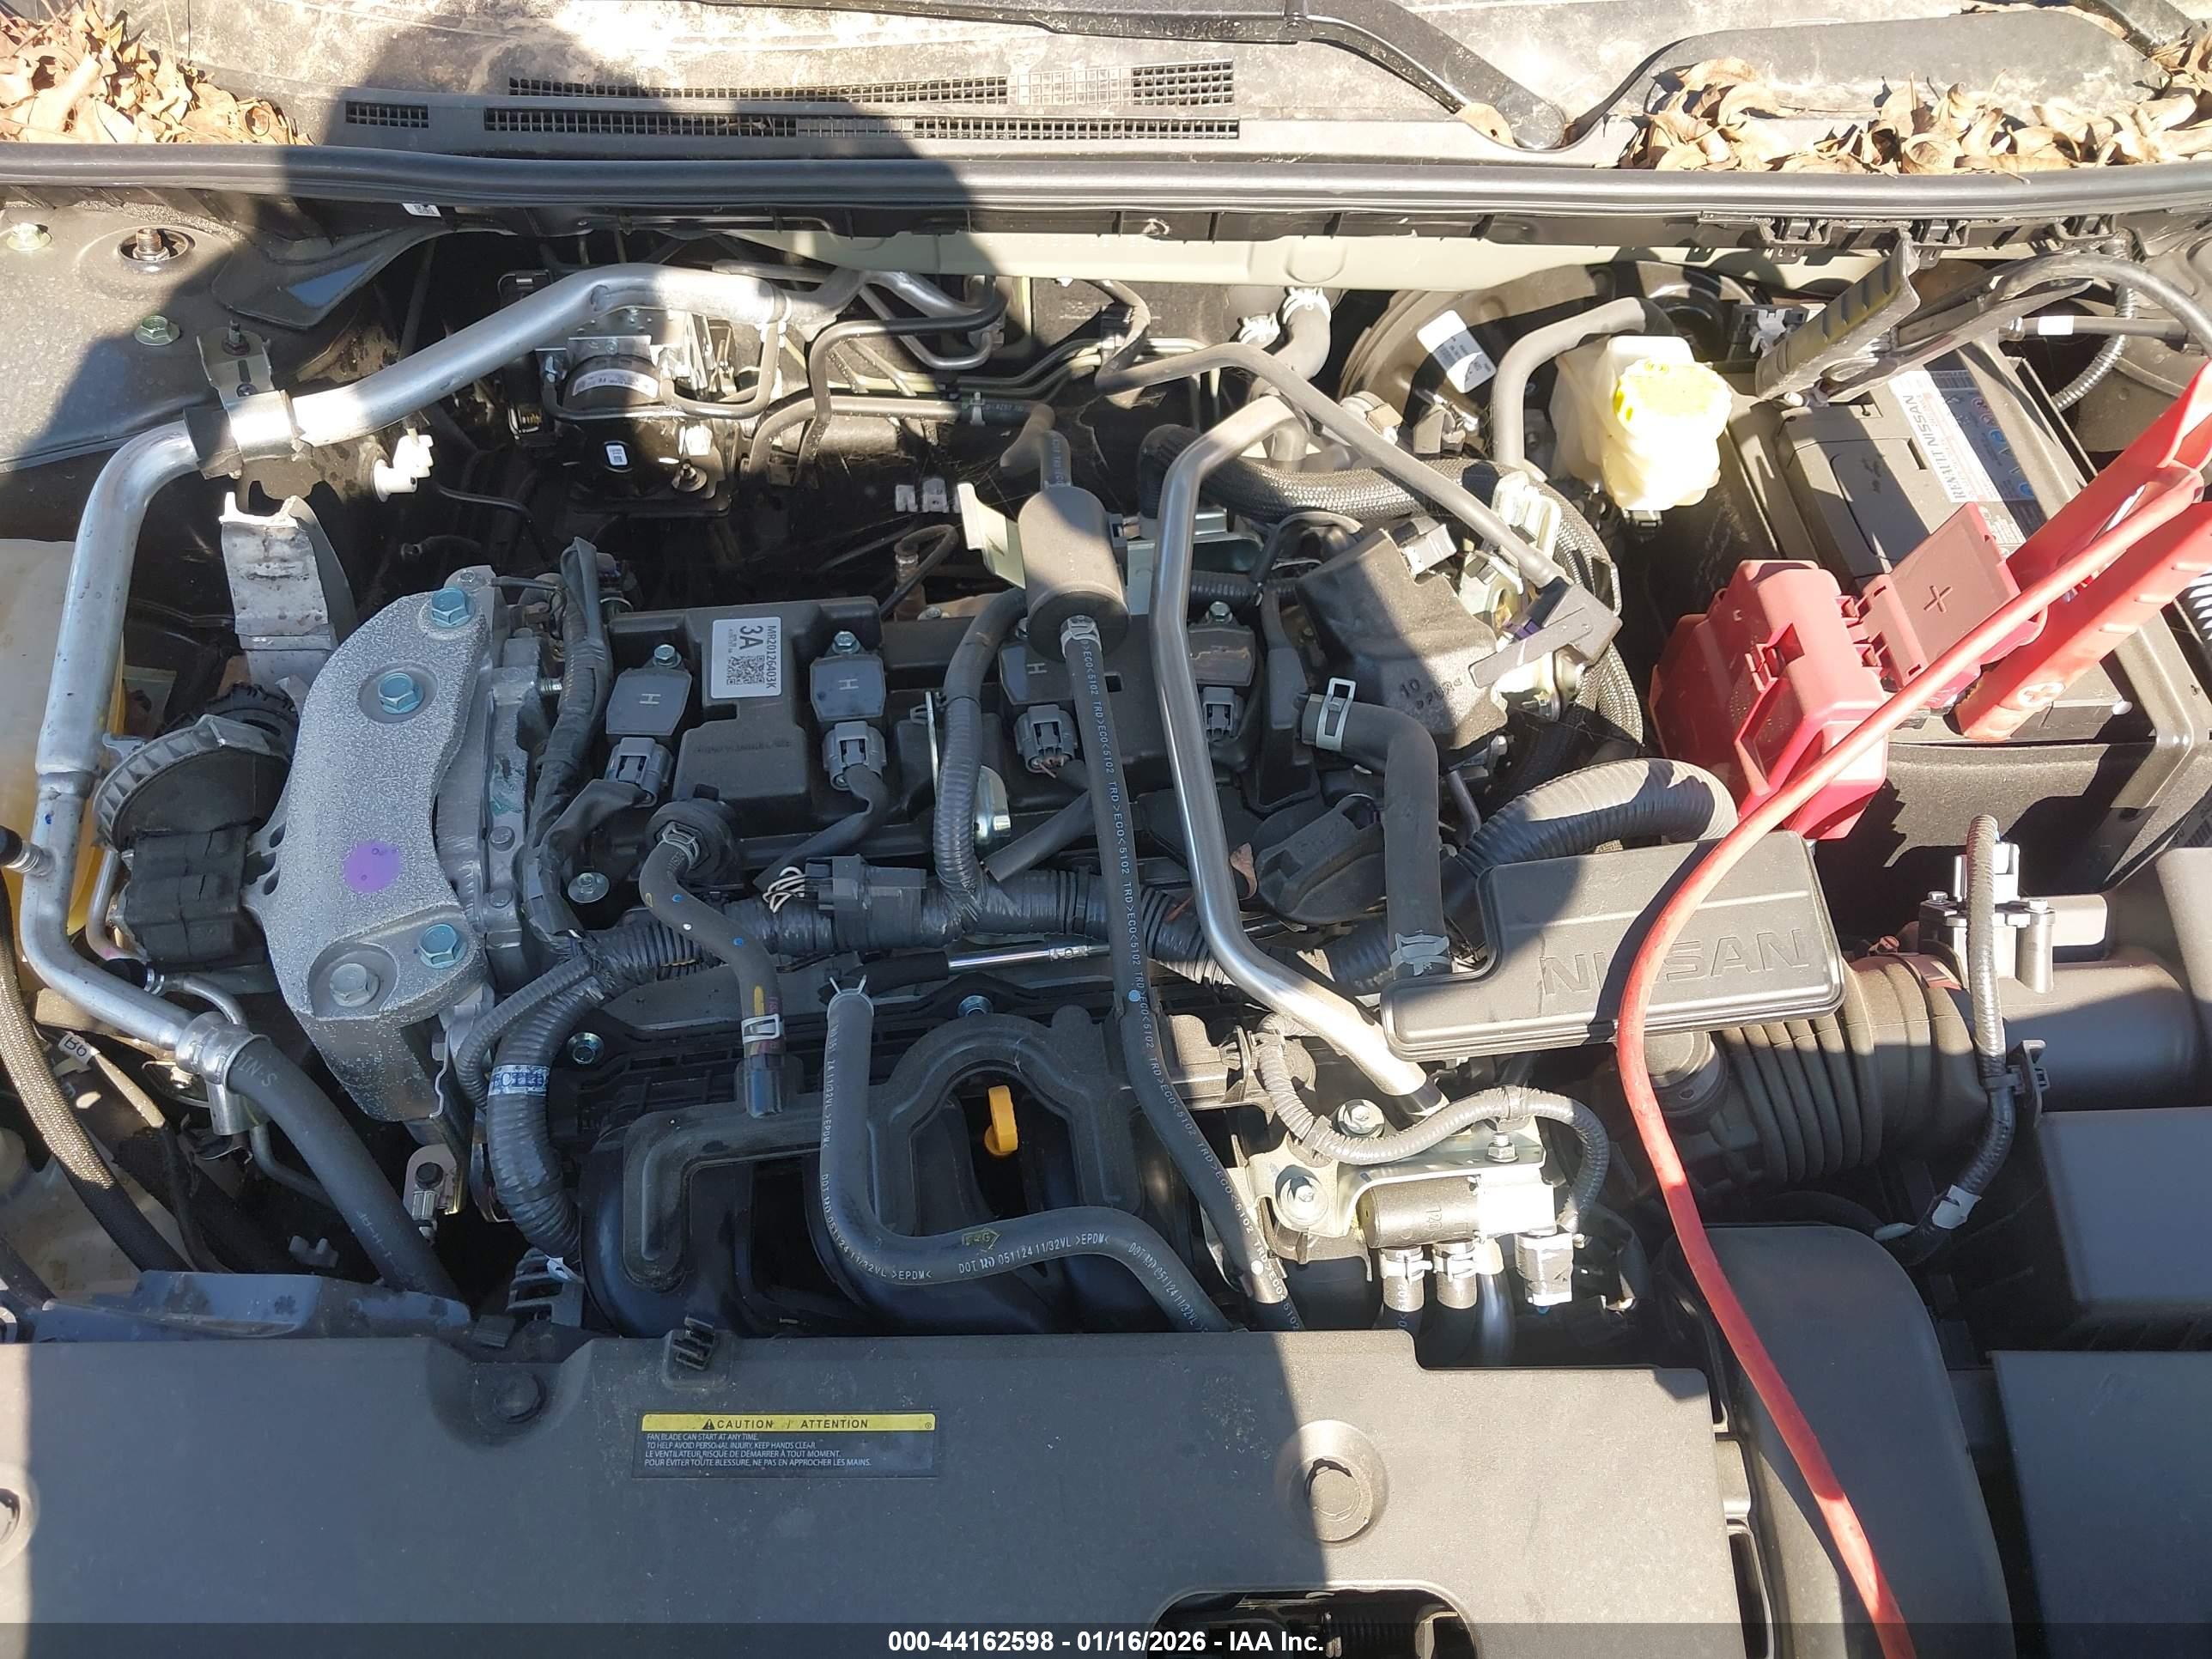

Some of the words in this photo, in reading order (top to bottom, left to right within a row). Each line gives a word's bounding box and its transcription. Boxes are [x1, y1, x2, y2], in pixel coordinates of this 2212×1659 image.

[1903, 394, 1939, 447] NISSAN
[1931, 450, 1966, 499] RENAULT
[739, 625, 764, 650] 3A
[717, 1419, 774, 1429] CAUTION
[800, 1419, 869, 1429] ATTENTION
[702, 1450, 730, 1459] RISQUE
